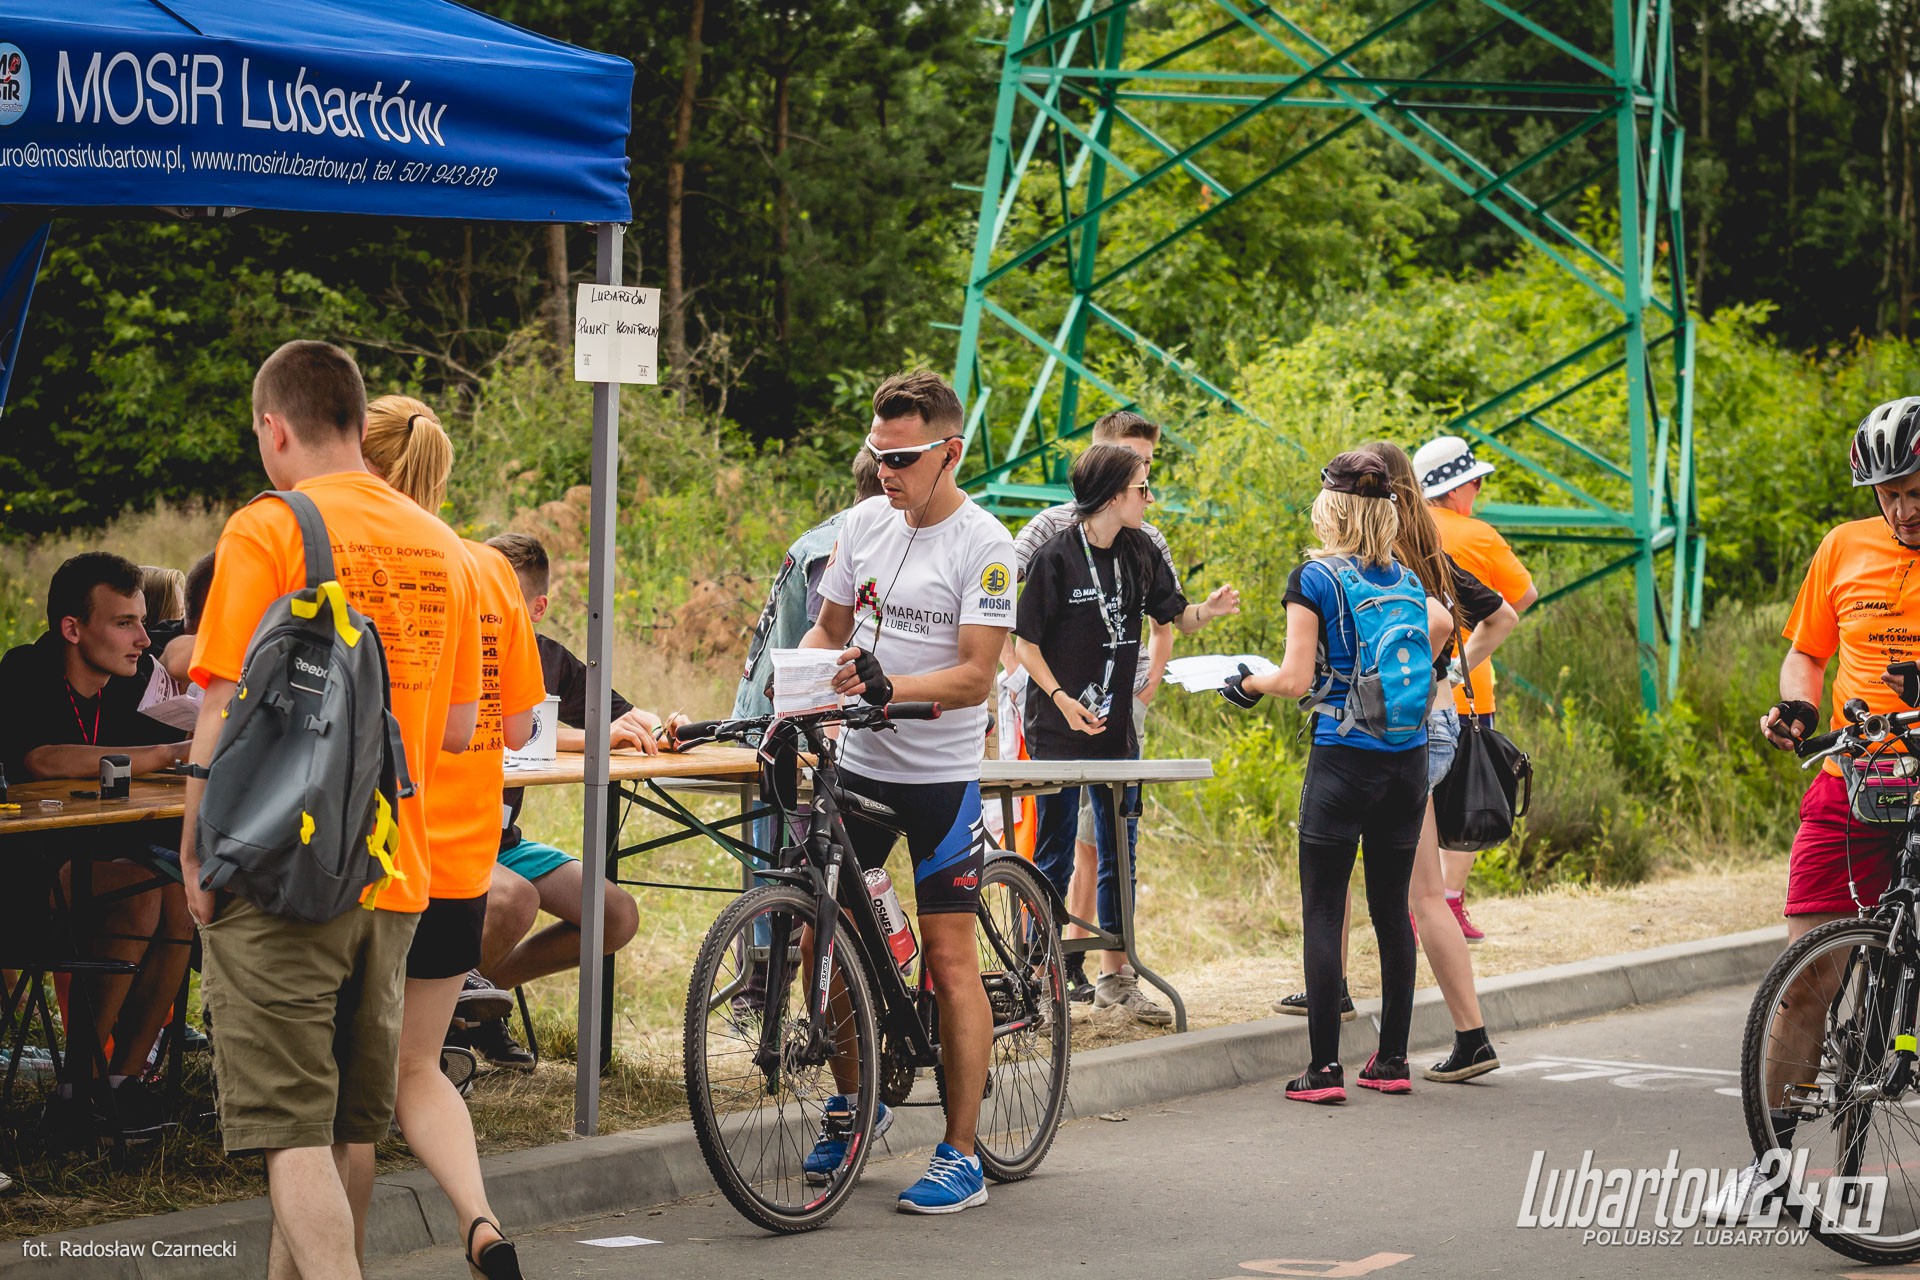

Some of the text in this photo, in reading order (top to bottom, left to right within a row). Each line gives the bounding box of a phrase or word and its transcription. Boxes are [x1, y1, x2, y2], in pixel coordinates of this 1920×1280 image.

[56, 50, 447, 148] MOSiR Lubartów
[191, 150, 368, 185] www.mosirlubartow.pl,
[373, 160, 394, 181] tel.
[400, 162, 432, 182] 501
[432, 164, 466, 184] 943
[464, 167, 498, 187] 818
[577, 316, 610, 335] PUNKT
[349, 542, 392, 556] ŚWIĘTO
[397, 547, 445, 559] ROWERU
[420, 582, 447, 594] wibro
[979, 597, 1011, 611] MOSiR
[886, 604, 953, 625] MARATON
[884, 617, 930, 635] LUBELSKI
[295, 656, 328, 679] Reebo
